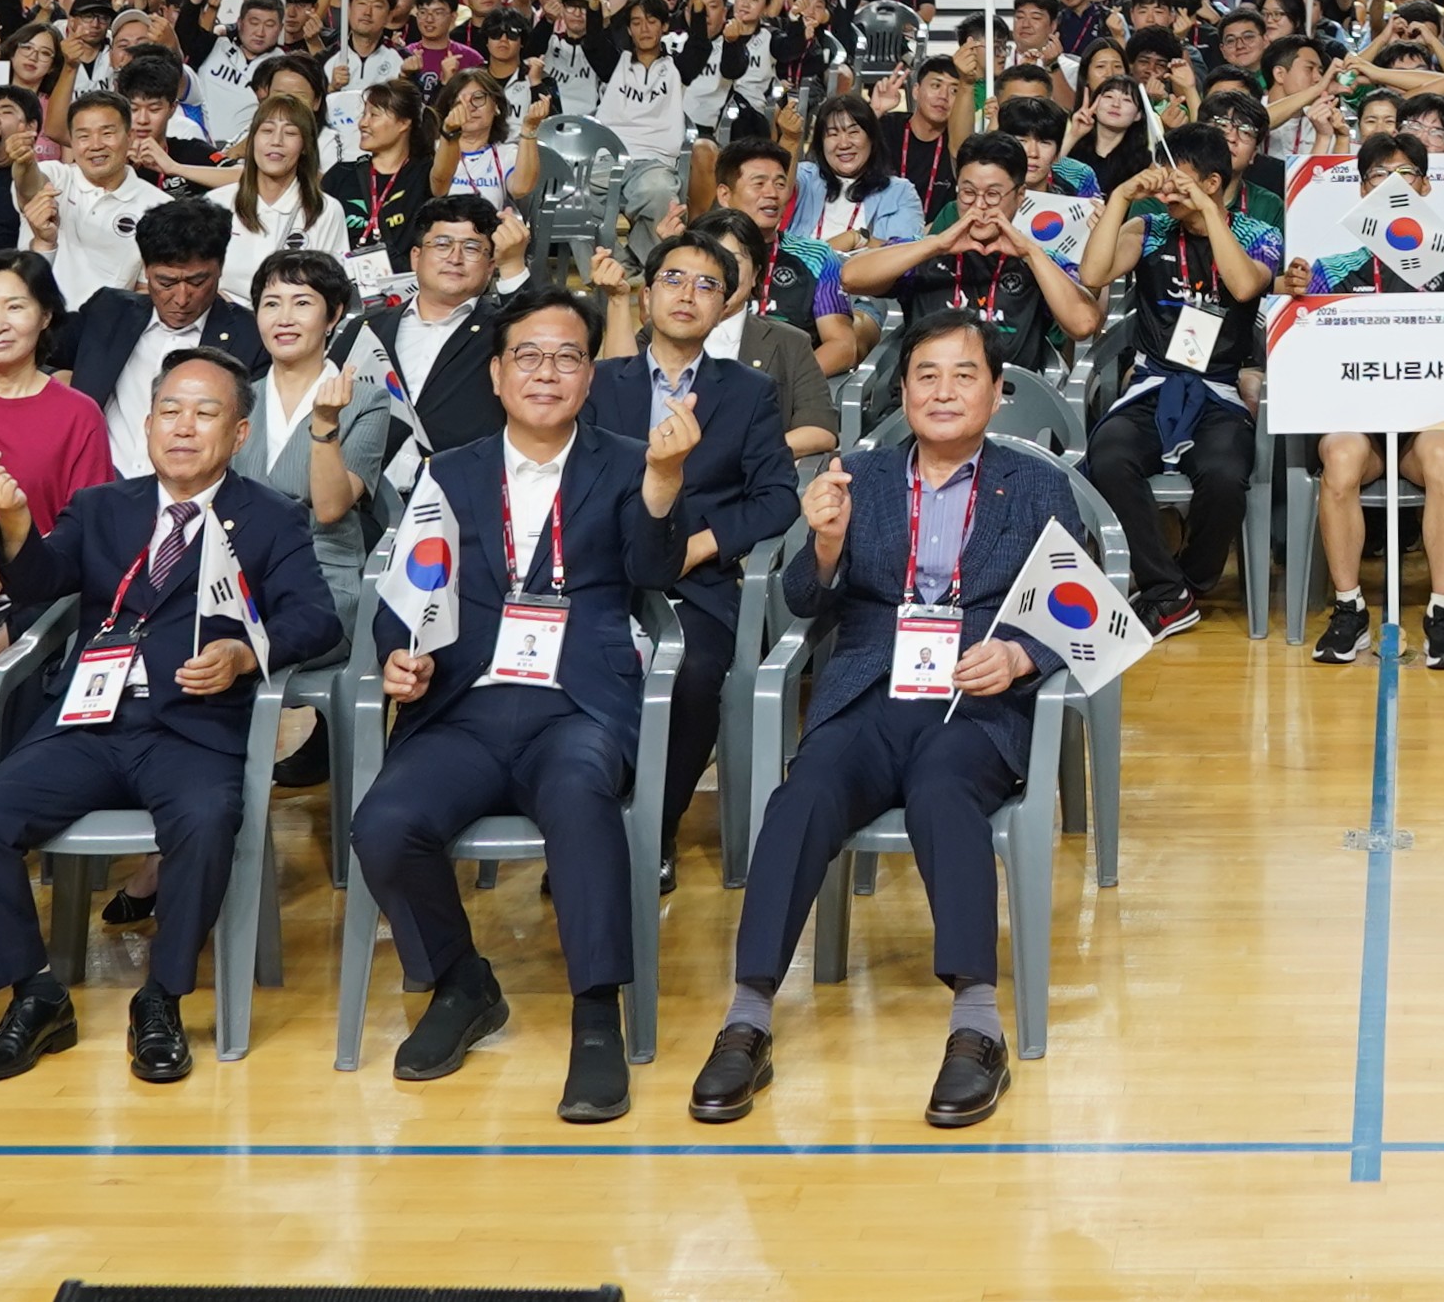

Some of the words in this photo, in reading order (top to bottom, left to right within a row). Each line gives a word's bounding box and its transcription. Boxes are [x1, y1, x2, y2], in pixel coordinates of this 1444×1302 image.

[1331, 166, 1349, 174] 2026
[1316, 308, 1337, 316] 2026
[1341, 361, 1444, 381] 제주나르샤
